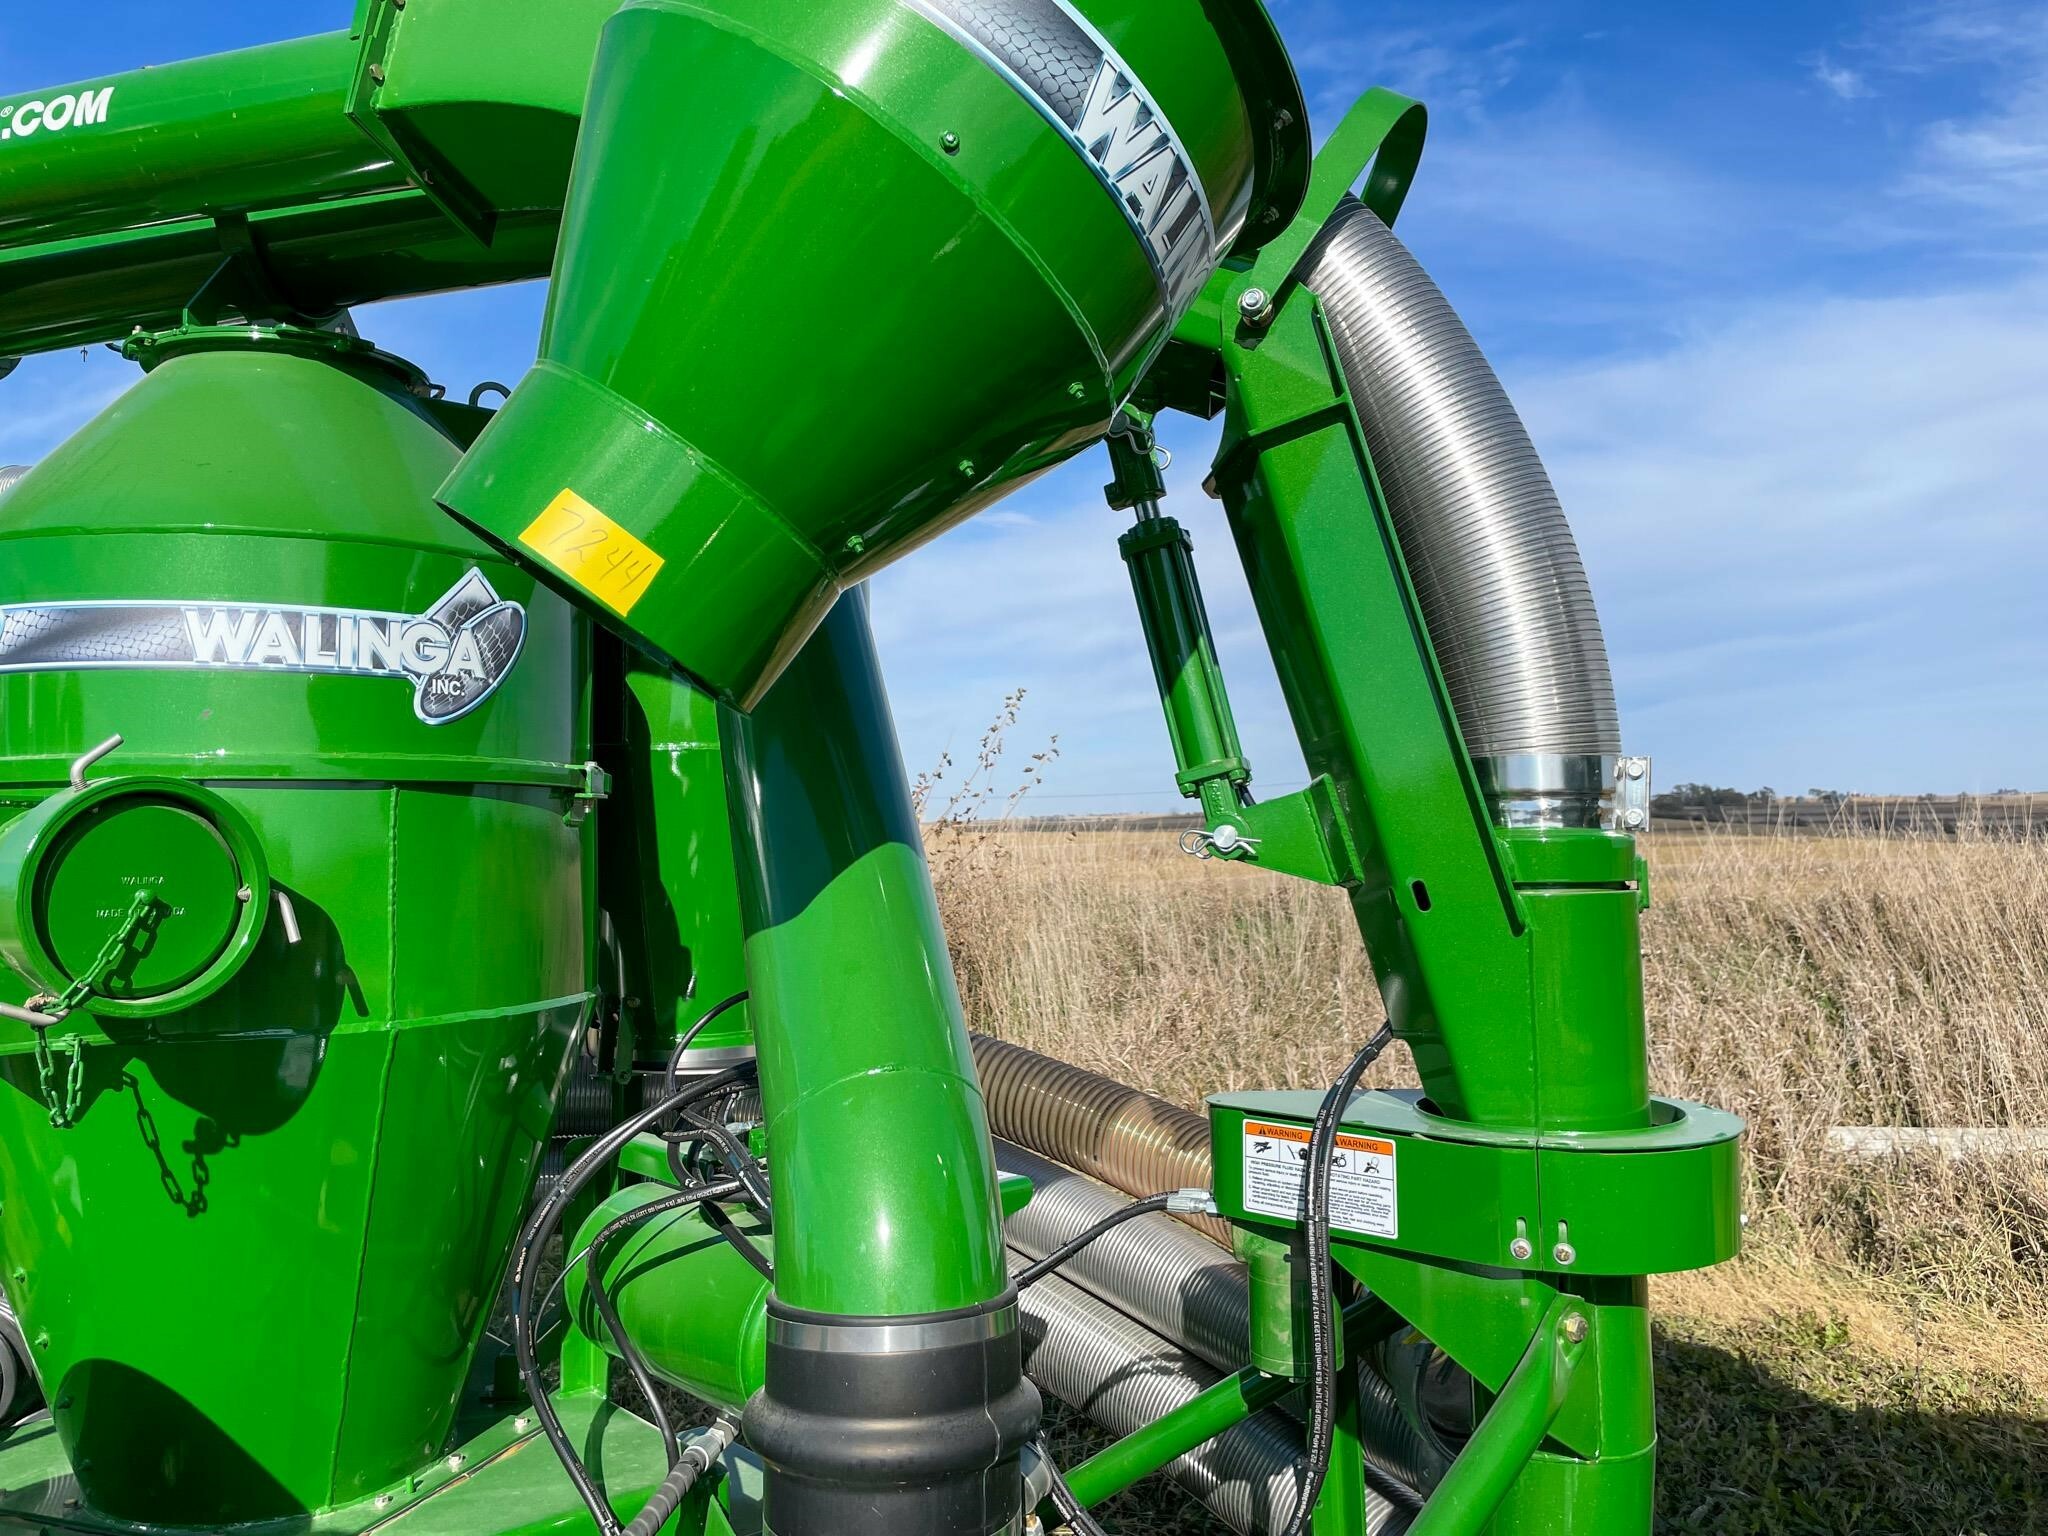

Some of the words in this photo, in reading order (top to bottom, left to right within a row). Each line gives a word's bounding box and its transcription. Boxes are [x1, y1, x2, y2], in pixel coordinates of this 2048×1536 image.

[1074, 54, 1211, 318] WALIN
[549, 507, 652, 592] 7244
[181, 606, 487, 678] WALINGA
[431, 678, 465, 698] INC.
[120, 876, 164, 886] WALINGA
[96, 908, 125, 919] MADE
[1266, 1127, 1303, 1140] WARNING
[1340, 1138, 1378, 1151] WARNING
[1310, 1262, 1318, 1287] 100R17
[1311, 1288, 1319, 1301] SAE
[1312, 1306, 1320, 1320] R17
[1313, 1321, 1321, 1341] 11237
[1314, 1342, 1322, 1354] ISO
[1312, 1434, 1320, 1449] MPa
